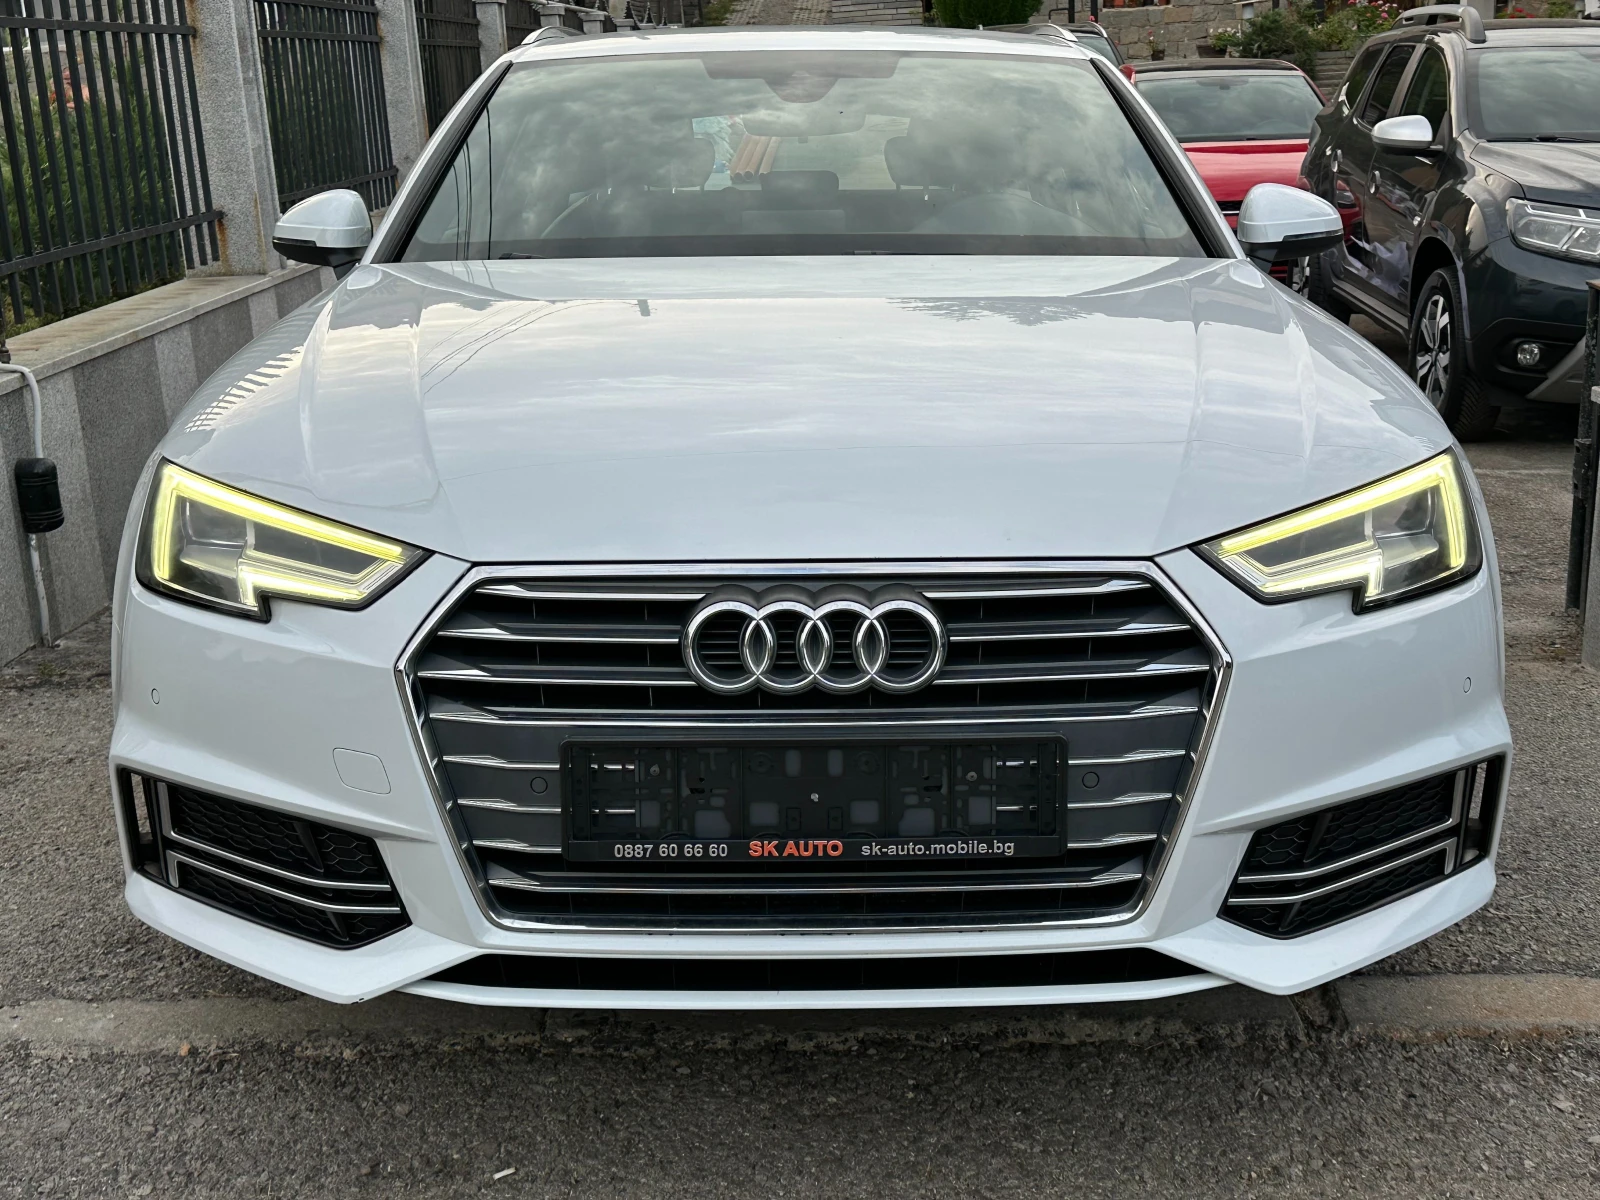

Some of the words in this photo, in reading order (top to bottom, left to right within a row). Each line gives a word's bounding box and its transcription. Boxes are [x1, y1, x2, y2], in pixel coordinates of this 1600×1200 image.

[614, 844, 653, 857] 0887
[659, 843, 677, 856] 60
[684, 844, 702, 856] 66
[709, 843, 727, 856] 60
[748, 840, 778, 856] SK
[782, 840, 842, 856] AUTO
[861, 840, 1014, 855] sk-auto.mobile.bg
